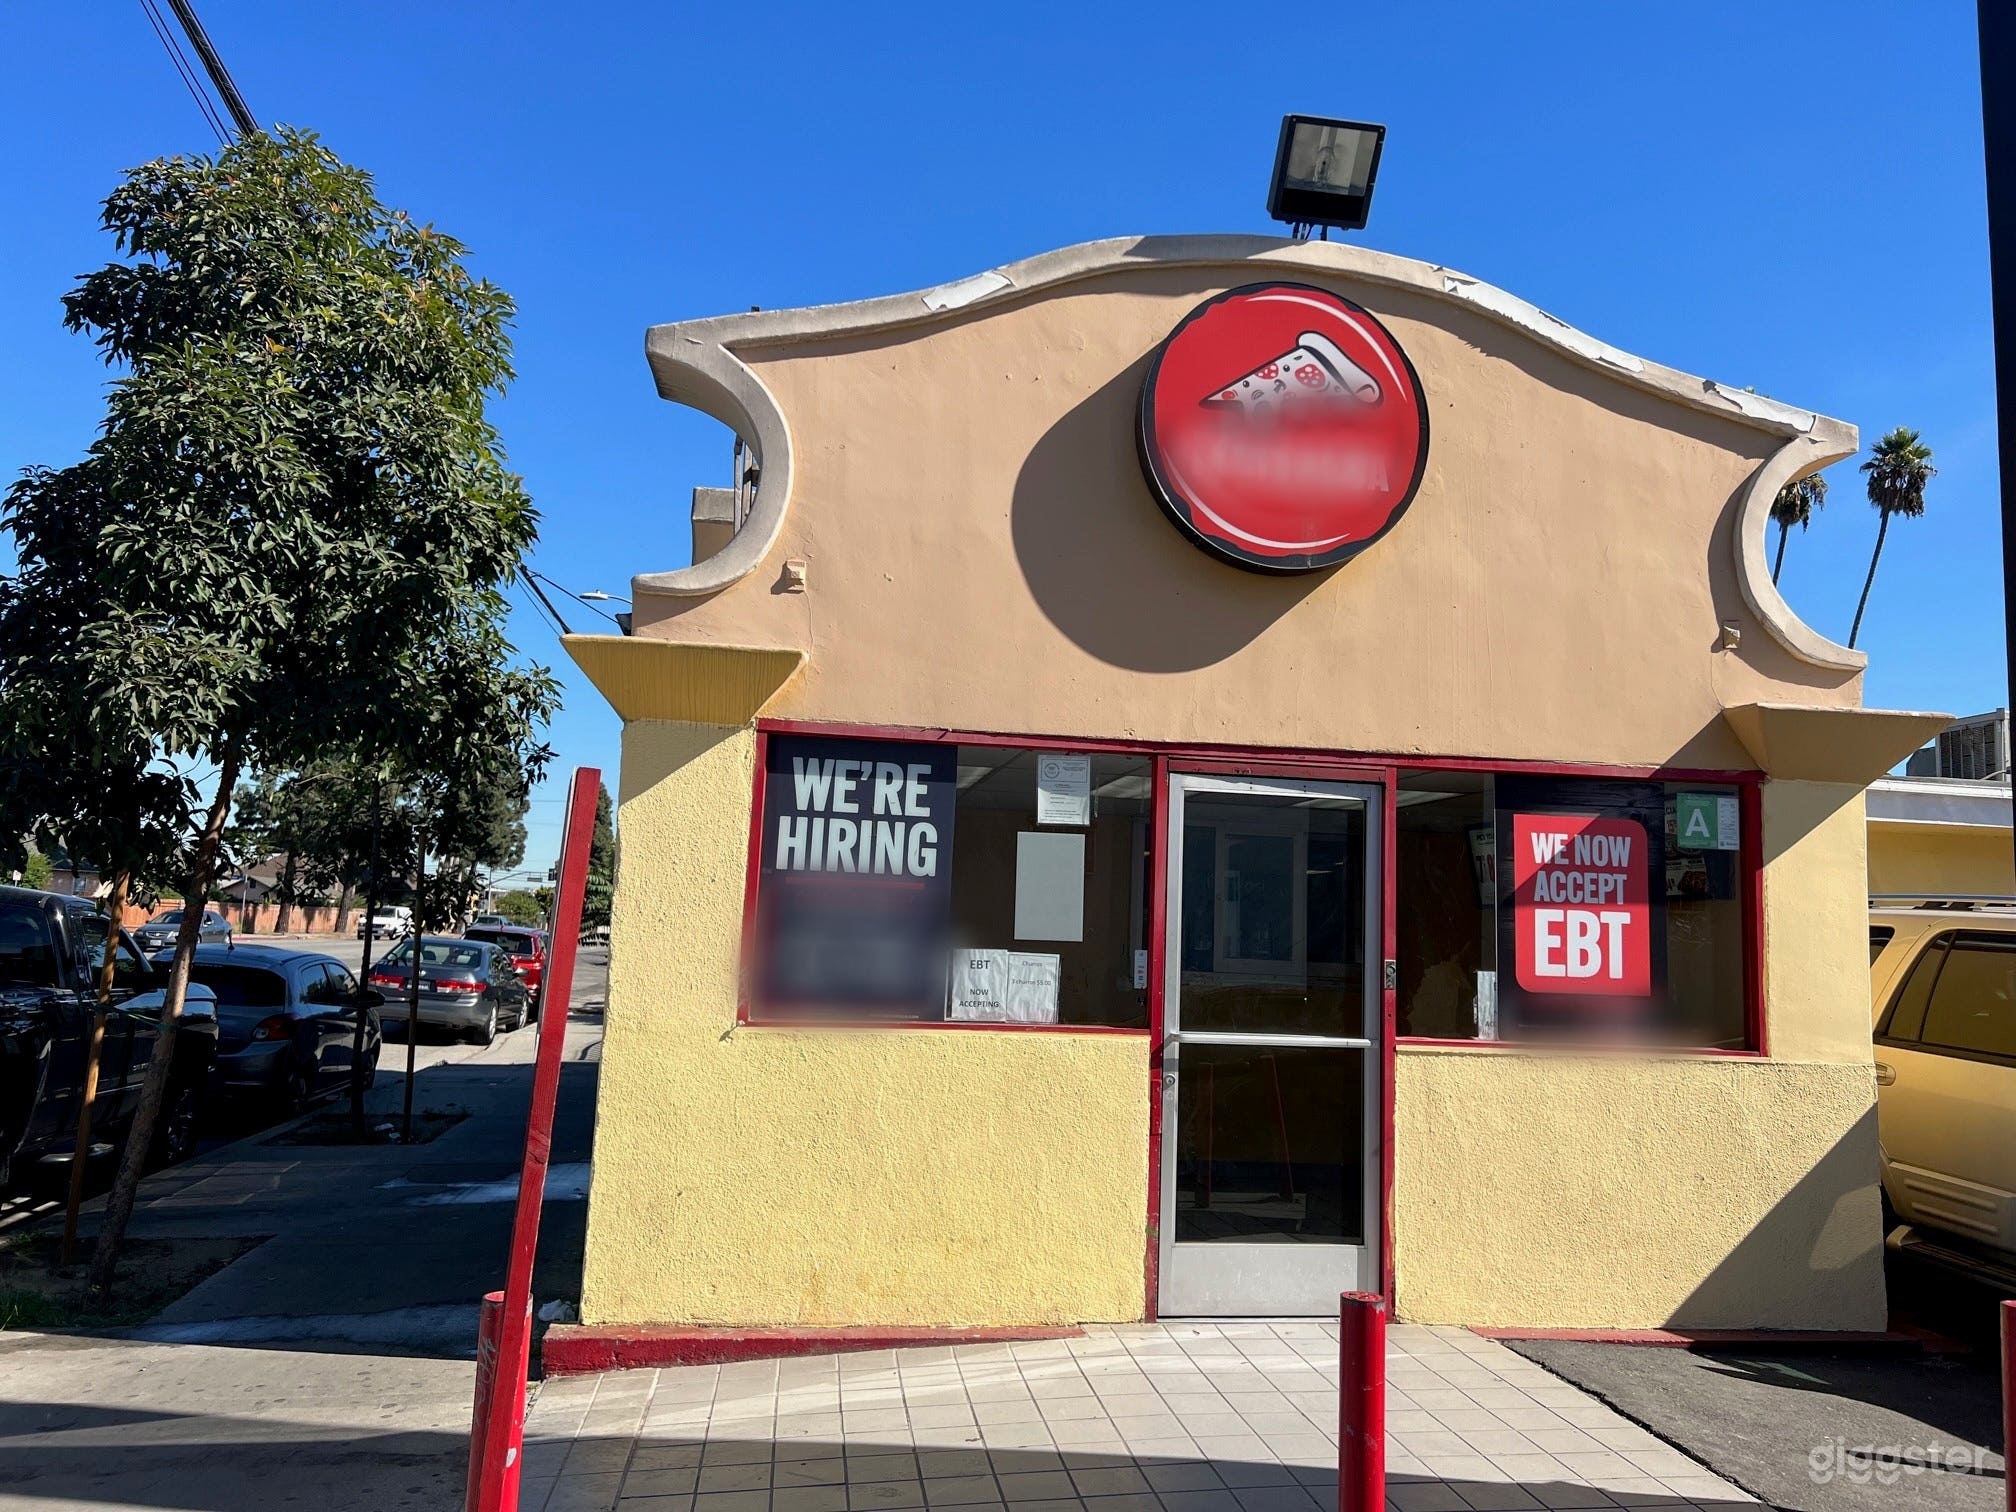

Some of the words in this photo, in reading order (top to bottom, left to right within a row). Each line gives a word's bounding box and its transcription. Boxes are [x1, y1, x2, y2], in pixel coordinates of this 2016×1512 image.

[792, 757, 932, 818] WE'RE
[1685, 808, 1710, 838] A
[776, 816, 938, 877] HIRING
[1531, 832, 1569, 865] WE
[1574, 834, 1632, 868] NOW
[1534, 870, 1628, 905] ACCEPT
[1534, 909, 1631, 979] EBT
[970, 959, 991, 969] EBT
[959, 1000, 1000, 1008] ACCEPTING
[969, 988, 989, 996] NOW
